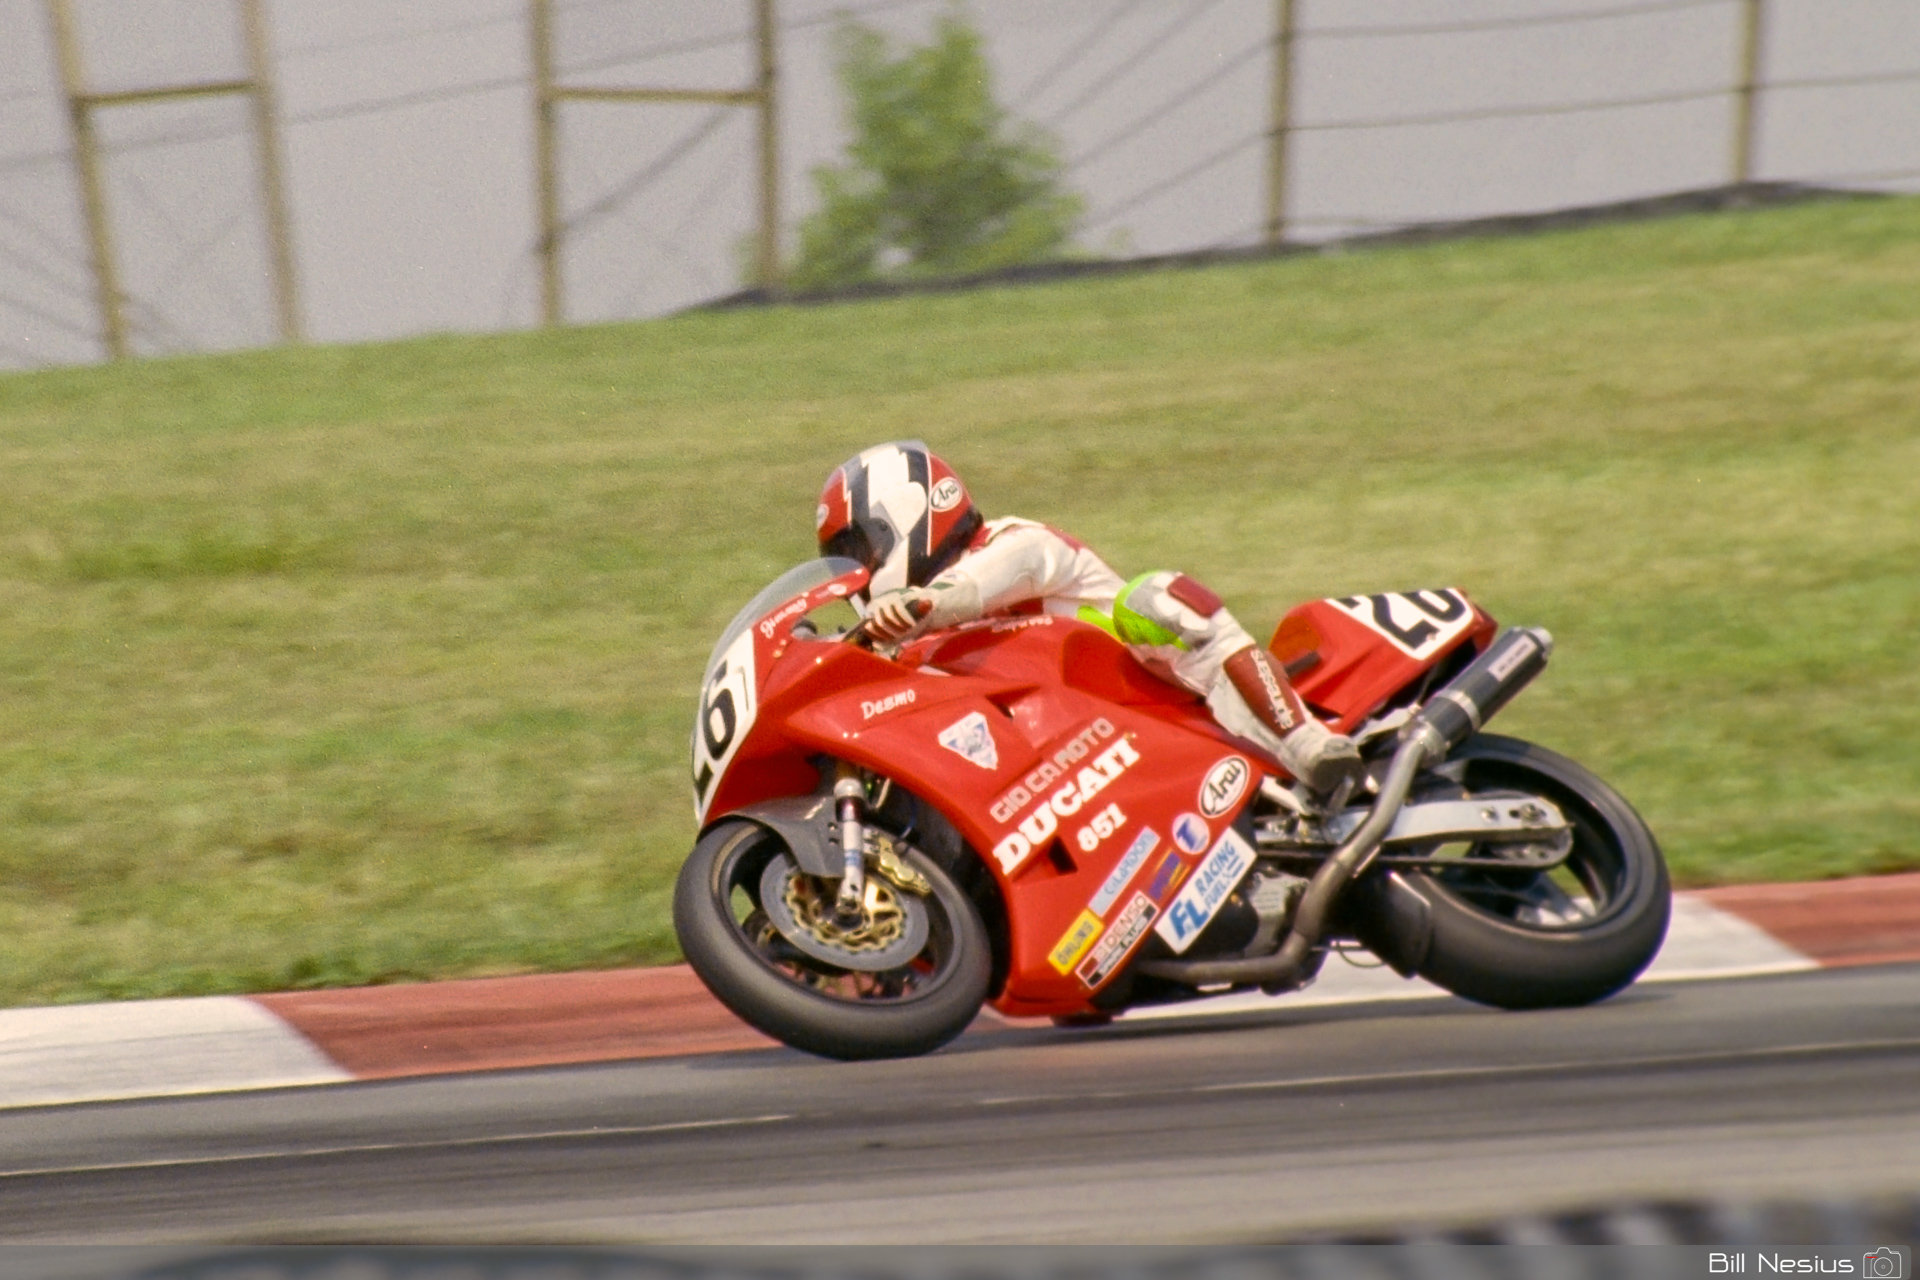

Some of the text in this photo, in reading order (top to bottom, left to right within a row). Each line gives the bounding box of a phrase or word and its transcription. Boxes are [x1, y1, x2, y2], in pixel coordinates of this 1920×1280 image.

[860, 689, 917, 721] Desmo
[992, 737, 1141, 876] DUCATI
[1204, 761, 1243, 814] Arai
[1076, 803, 1128, 853] 851
[1195, 840, 1237, 895] RACING
[1169, 897, 1210, 941] FL
